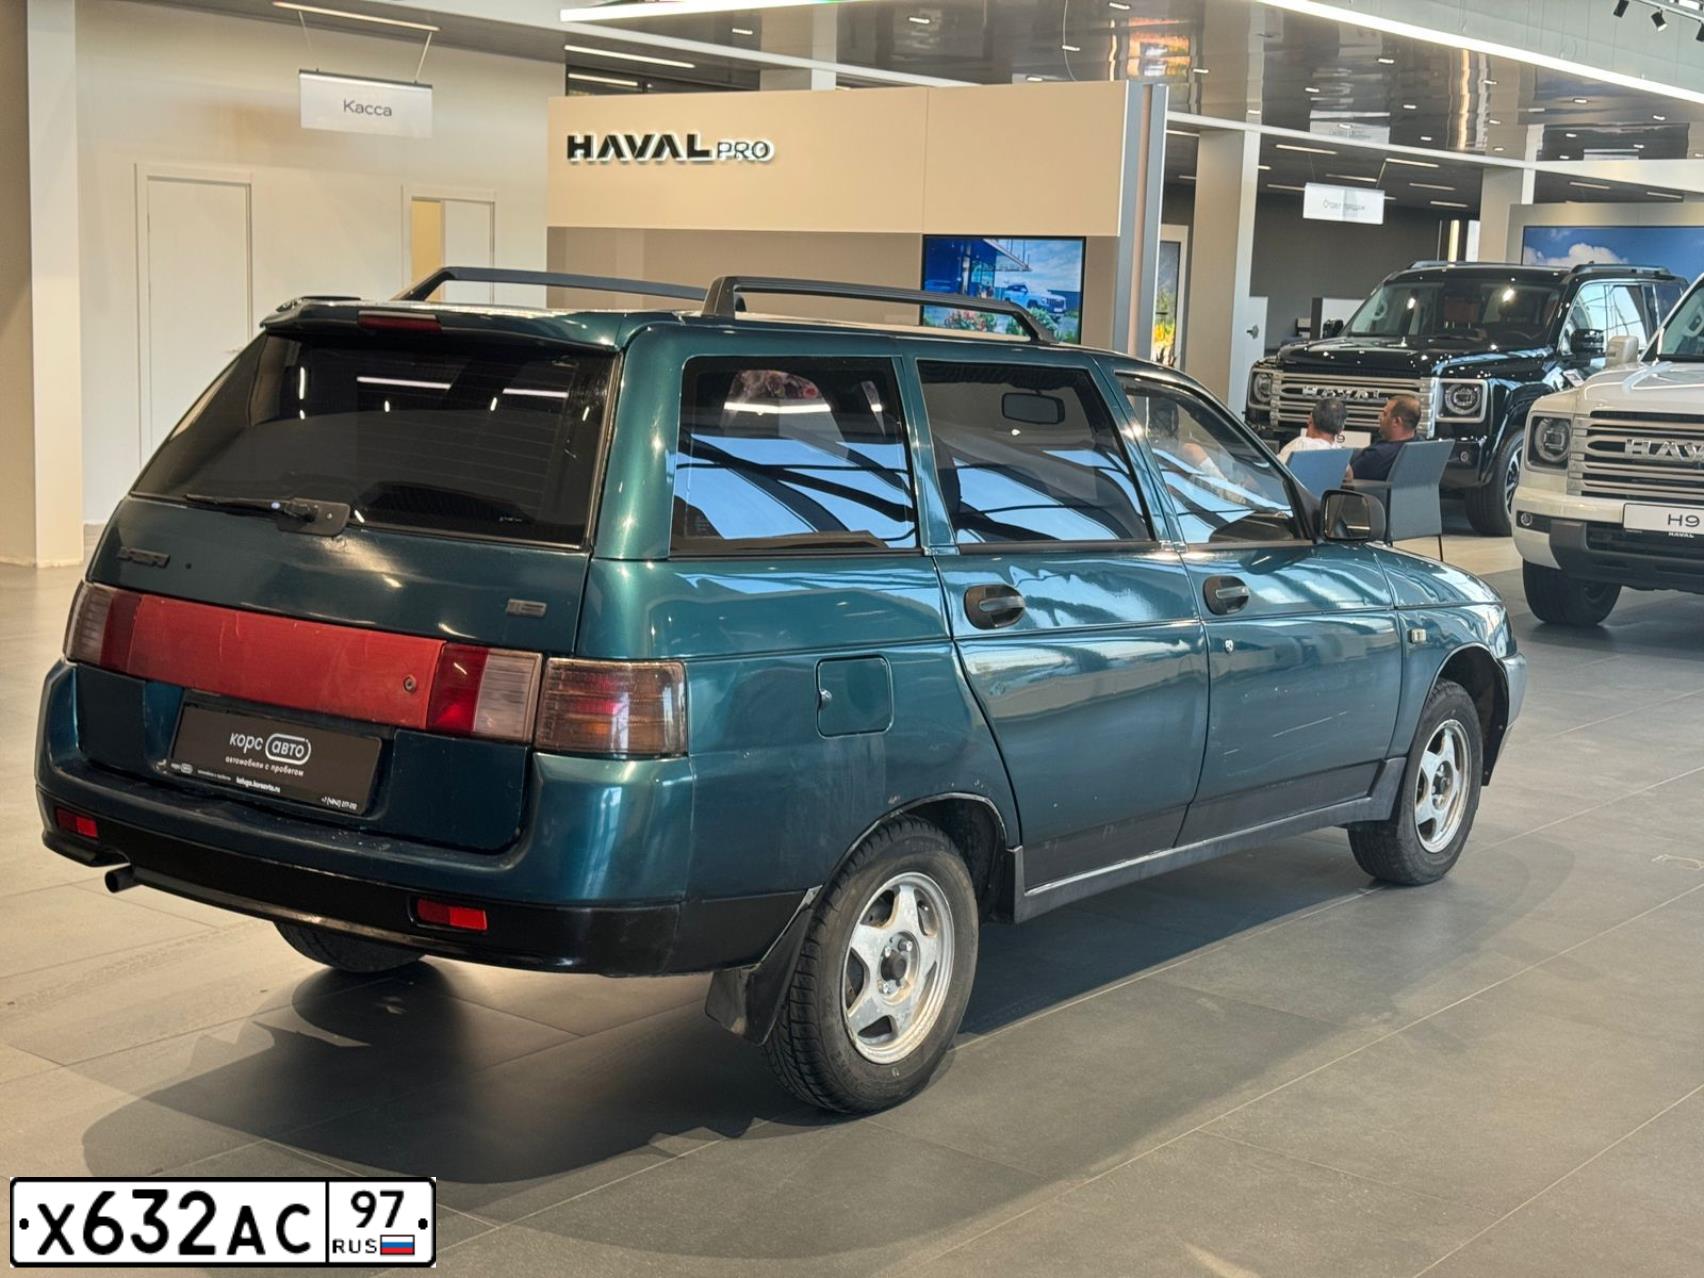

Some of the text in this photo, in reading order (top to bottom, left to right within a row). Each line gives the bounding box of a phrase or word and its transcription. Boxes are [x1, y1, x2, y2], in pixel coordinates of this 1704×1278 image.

[343, 98, 393, 117] Касса
[567, 134, 772, 160] HAVAL PRO
[1667, 513, 1700, 528] H9
[229, 732, 305, 758] корс авто
[225, 756, 264, 769] автомобили
[270, 764, 305, 777] пробегом
